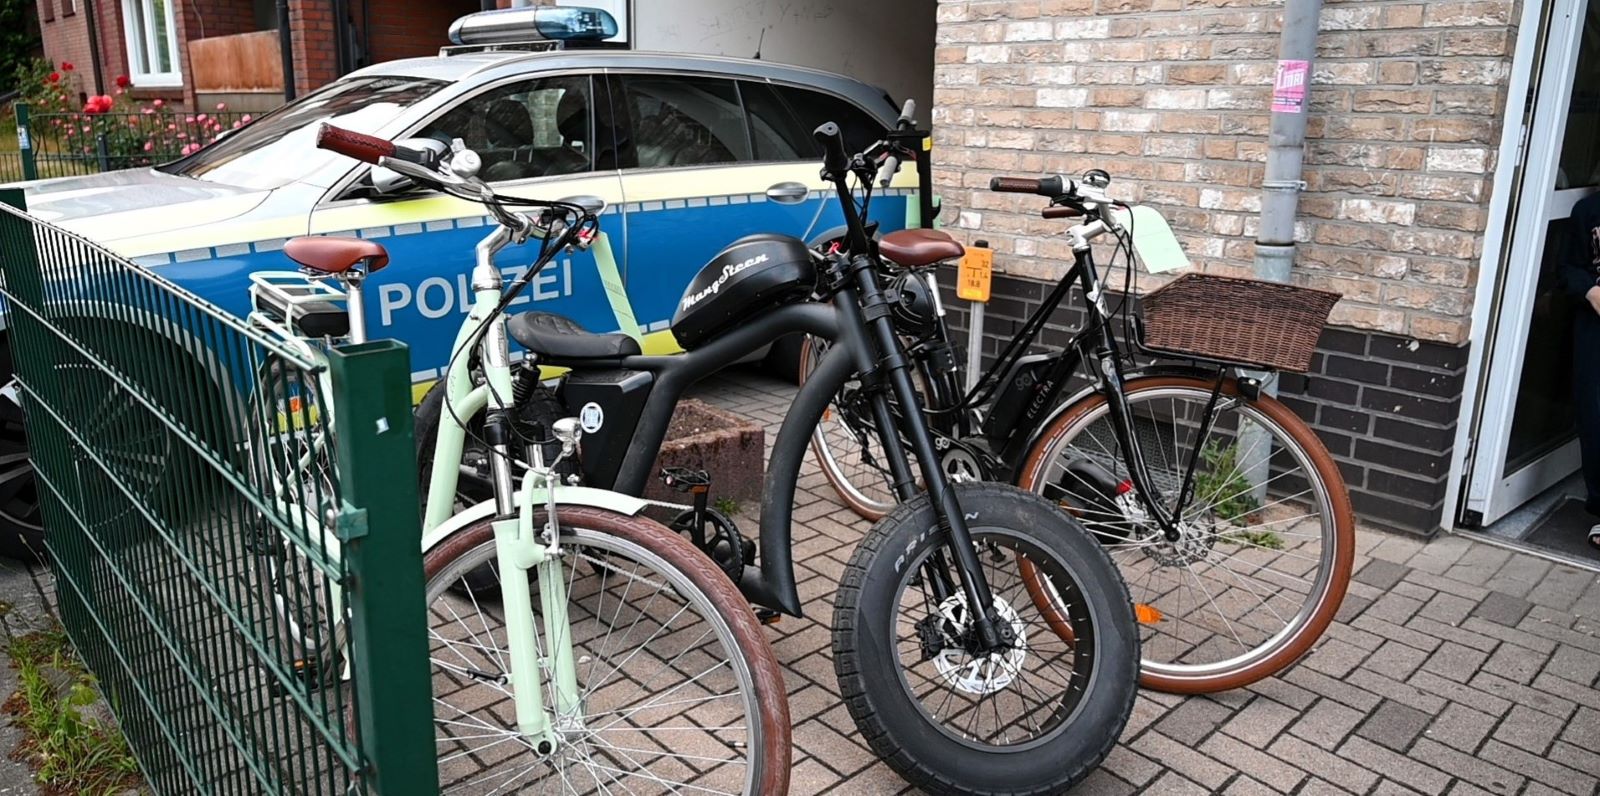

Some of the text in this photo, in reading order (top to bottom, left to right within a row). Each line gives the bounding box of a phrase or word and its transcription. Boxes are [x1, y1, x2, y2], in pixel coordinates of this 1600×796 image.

[378, 258, 572, 327] POLZEI
[681, 253, 770, 312] MangSteen
[1026, 379, 1055, 420] ELECTRA
[894, 511, 979, 573] ARISN
